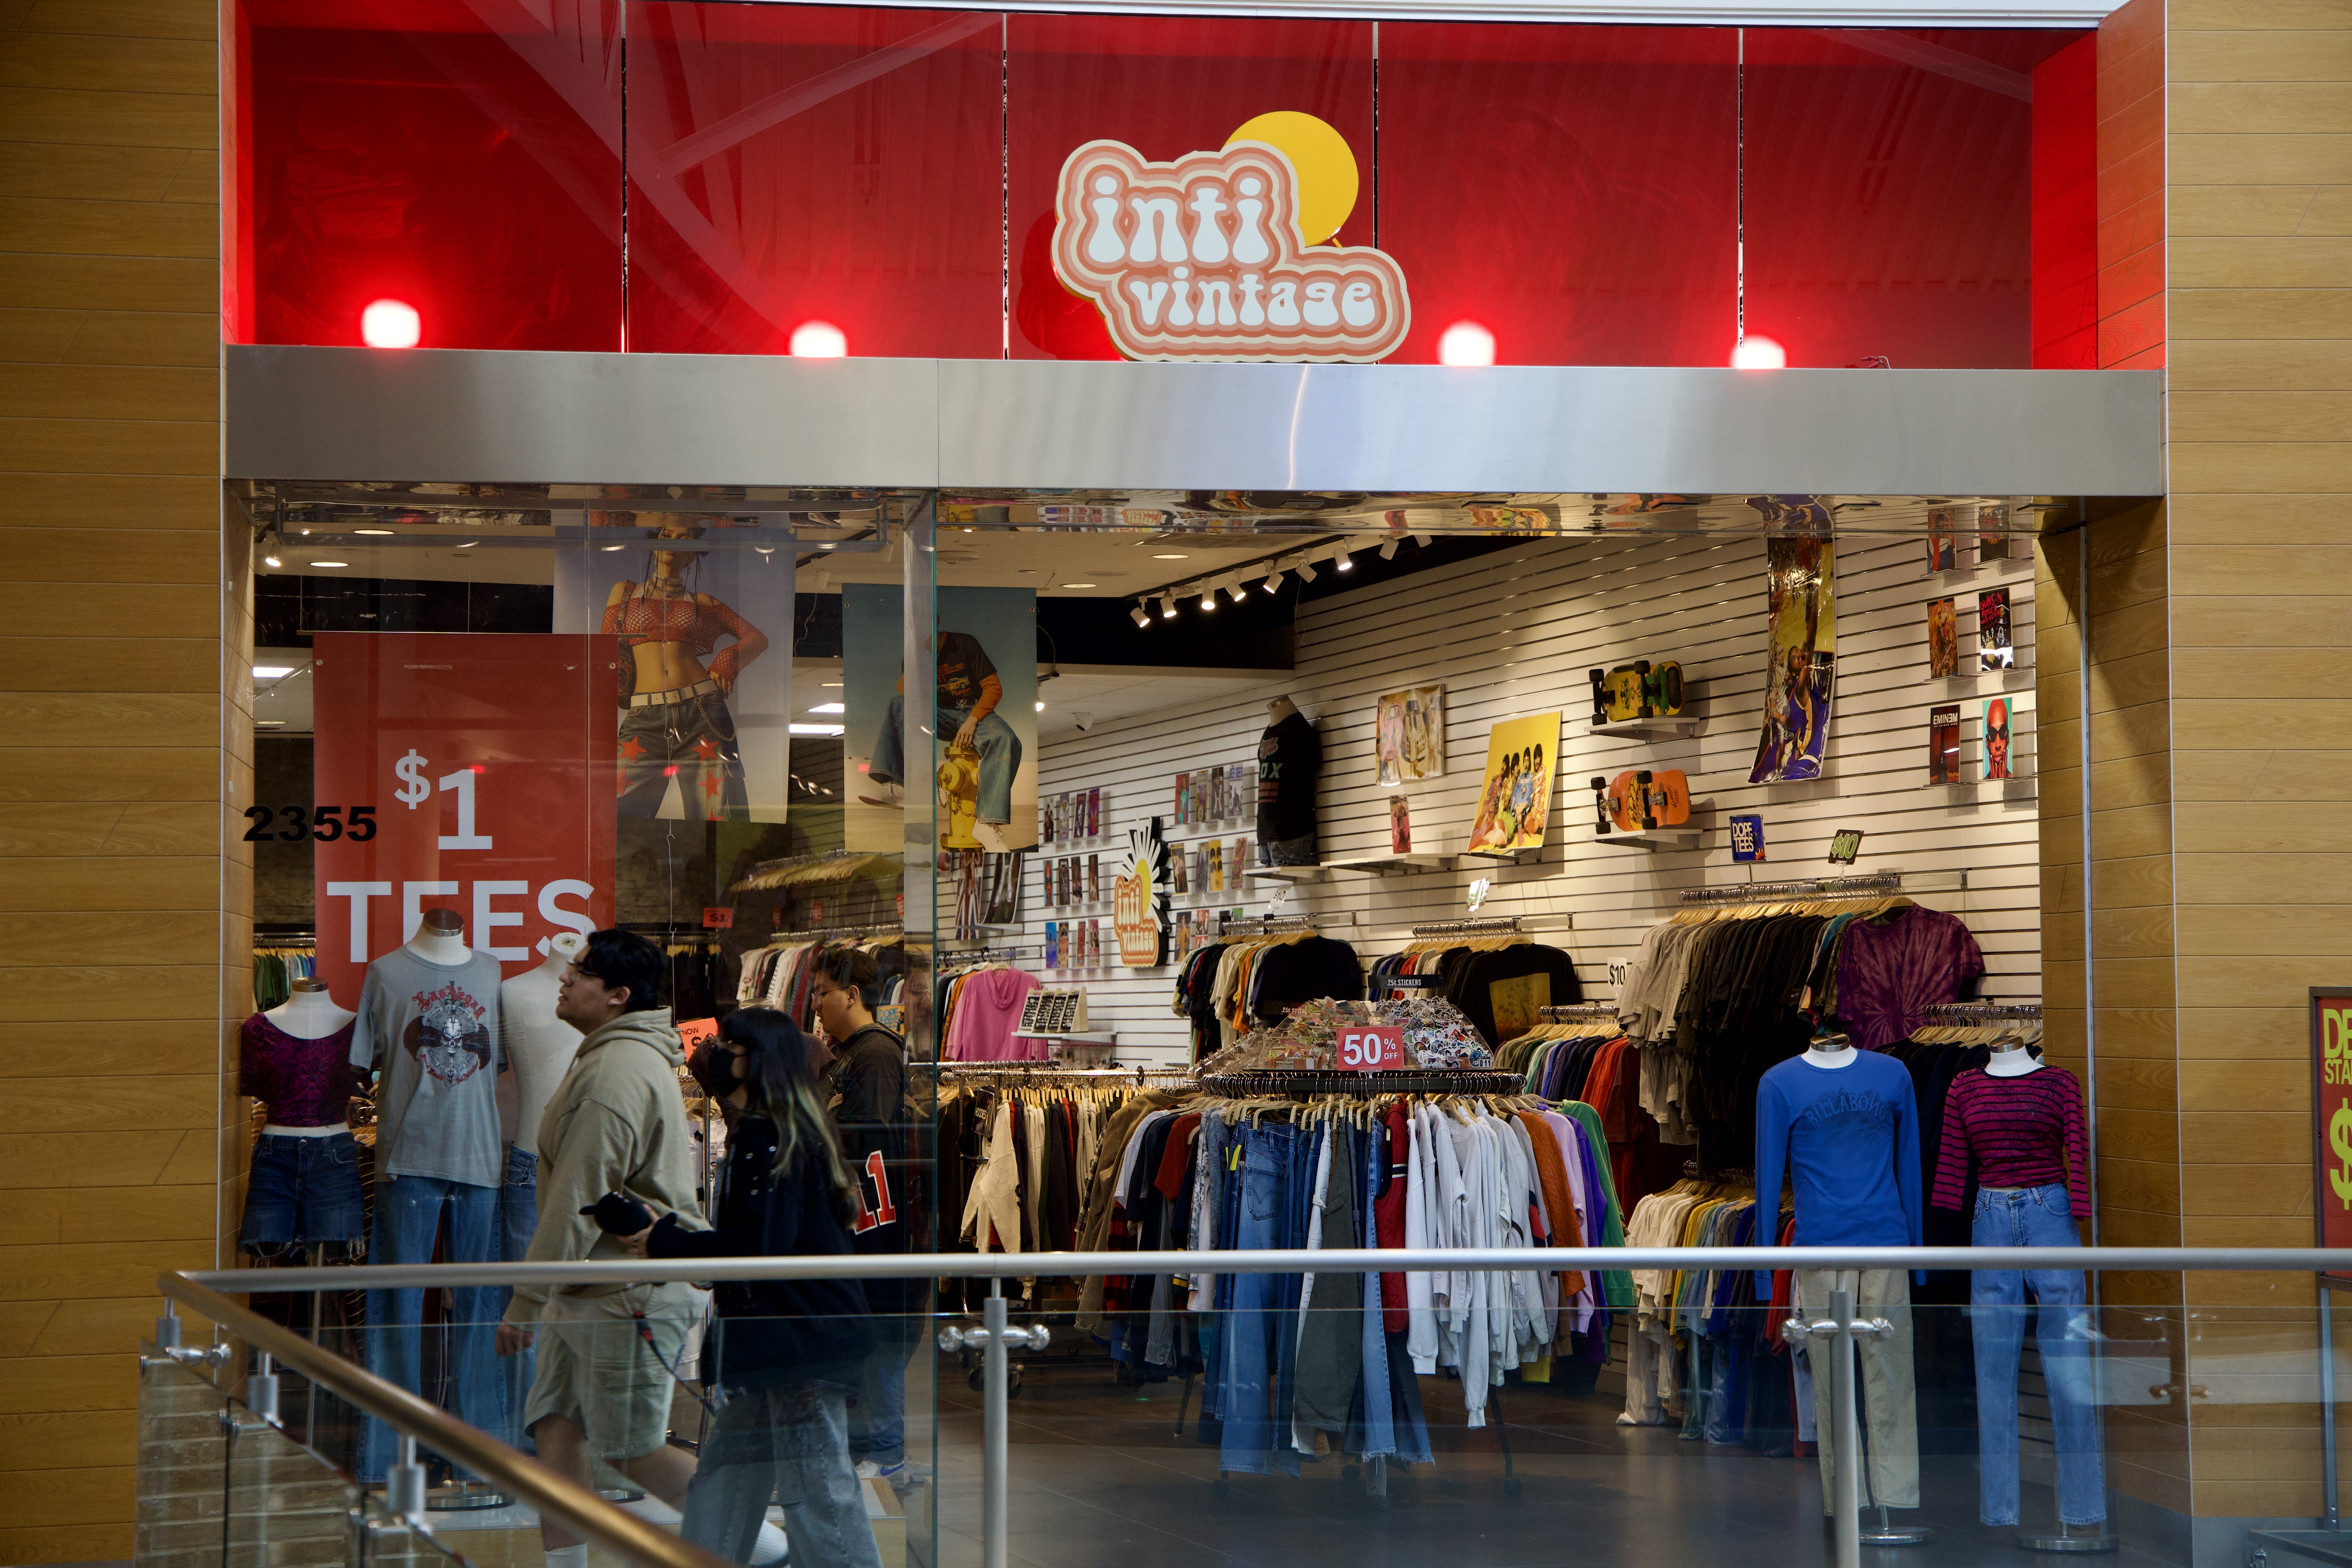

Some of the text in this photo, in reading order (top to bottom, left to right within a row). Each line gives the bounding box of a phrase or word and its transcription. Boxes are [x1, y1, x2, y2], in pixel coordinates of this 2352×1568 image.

[1088, 176, 1269, 263] inti
[1130, 267, 1375, 326] vintage
[1933, 712, 1958, 725] EMINEM
[1260, 762, 1283, 779] OX
[394, 749, 492, 850] $1
[243, 806, 376, 842] 2355
[1732, 822, 1753, 837] DOPE
[1733, 836, 1754, 852] TEES
[1831, 833, 1858, 858] $10
[1117, 887, 1140, 925] inti
[1122, 926, 1154, 952] vintage
[1610, 963, 1625, 987] $10
[412, 985, 486, 1021] Las Vegas
[879, 1008, 898, 1020] DOPE
[682, 1027, 698, 1036] NOW
[2325, 1059, 2352, 1085] STA
[975, 1107, 987, 1120] HOODIES
[1804, 1093, 1888, 1128] BILLABONG
